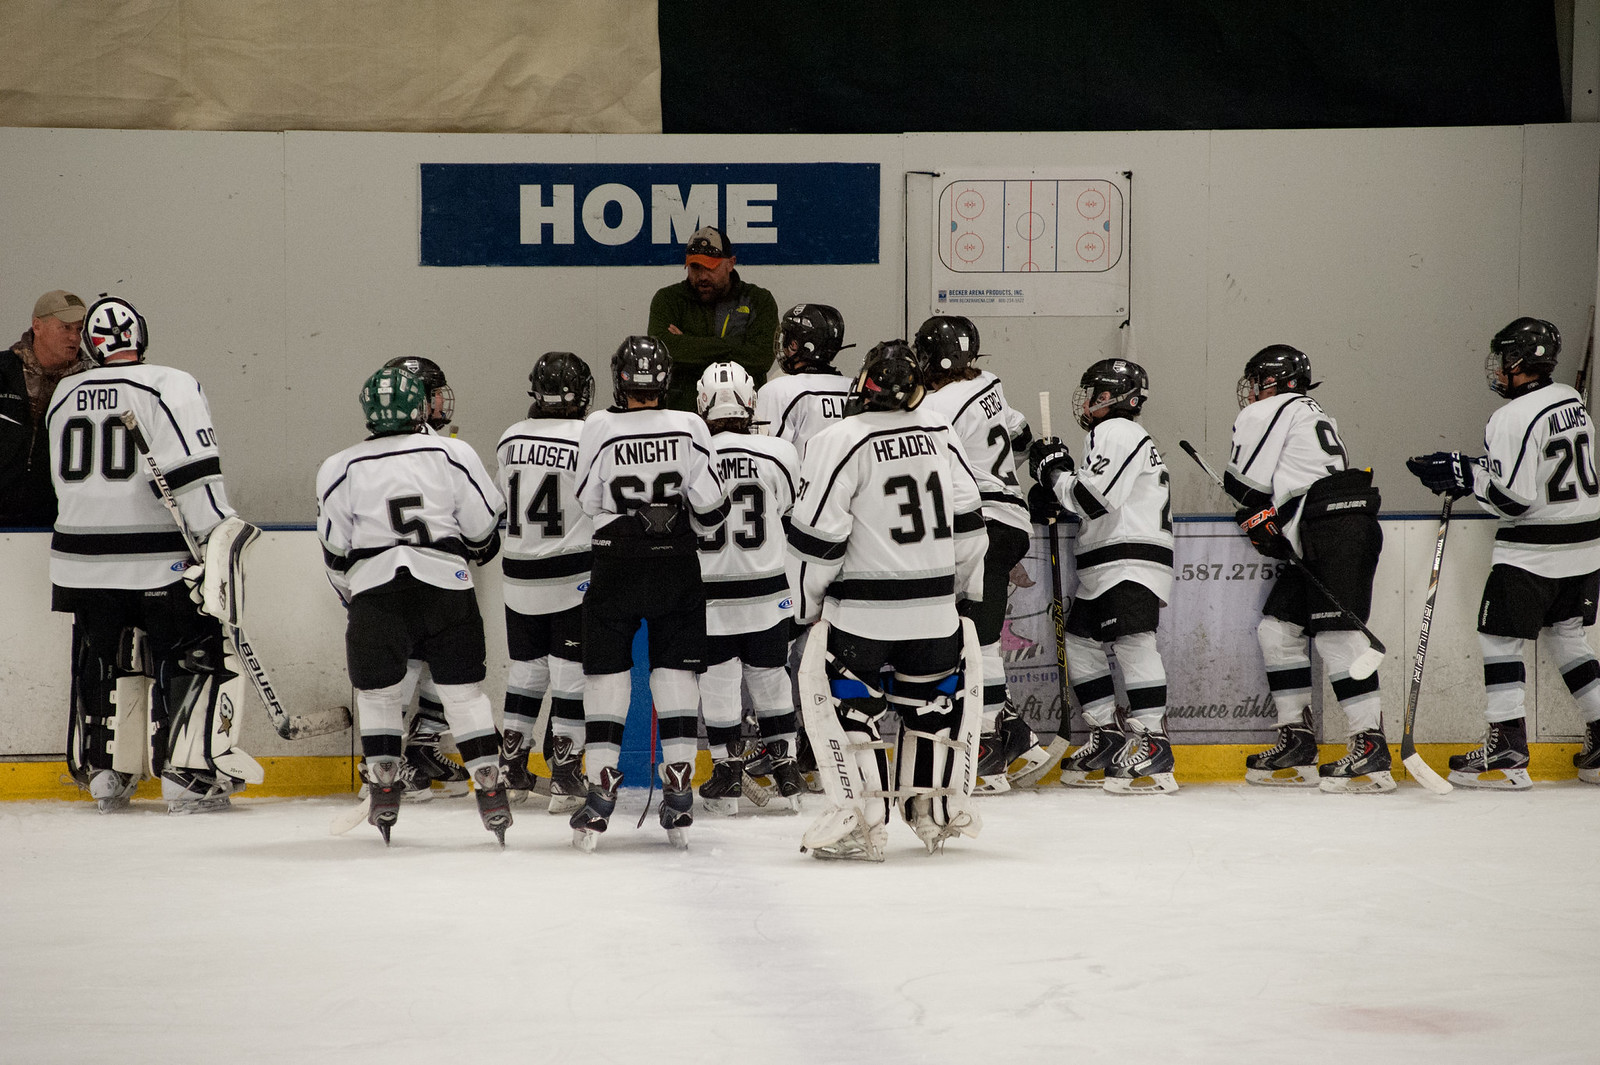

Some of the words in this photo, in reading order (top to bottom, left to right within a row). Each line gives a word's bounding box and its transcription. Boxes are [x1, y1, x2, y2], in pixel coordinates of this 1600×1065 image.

[519, 183, 778, 246] HOME
[77, 388, 118, 412] BYRD
[59, 414, 138, 484] 00
[614, 438, 679, 466] KNIGHT
[873, 434, 937, 463] HEADEN
[1542, 431, 1600, 505] 20
[146, 456, 177, 508] BAUER
[507, 469, 565, 539] 14
[883, 470, 952, 546] 31
[385, 494, 433, 546] 5
[591, 538, 612, 547] AUER
[240, 642, 283, 717] BAUER
[829, 738, 854, 800] BAUER
[963, 731, 973, 796] BAUER
